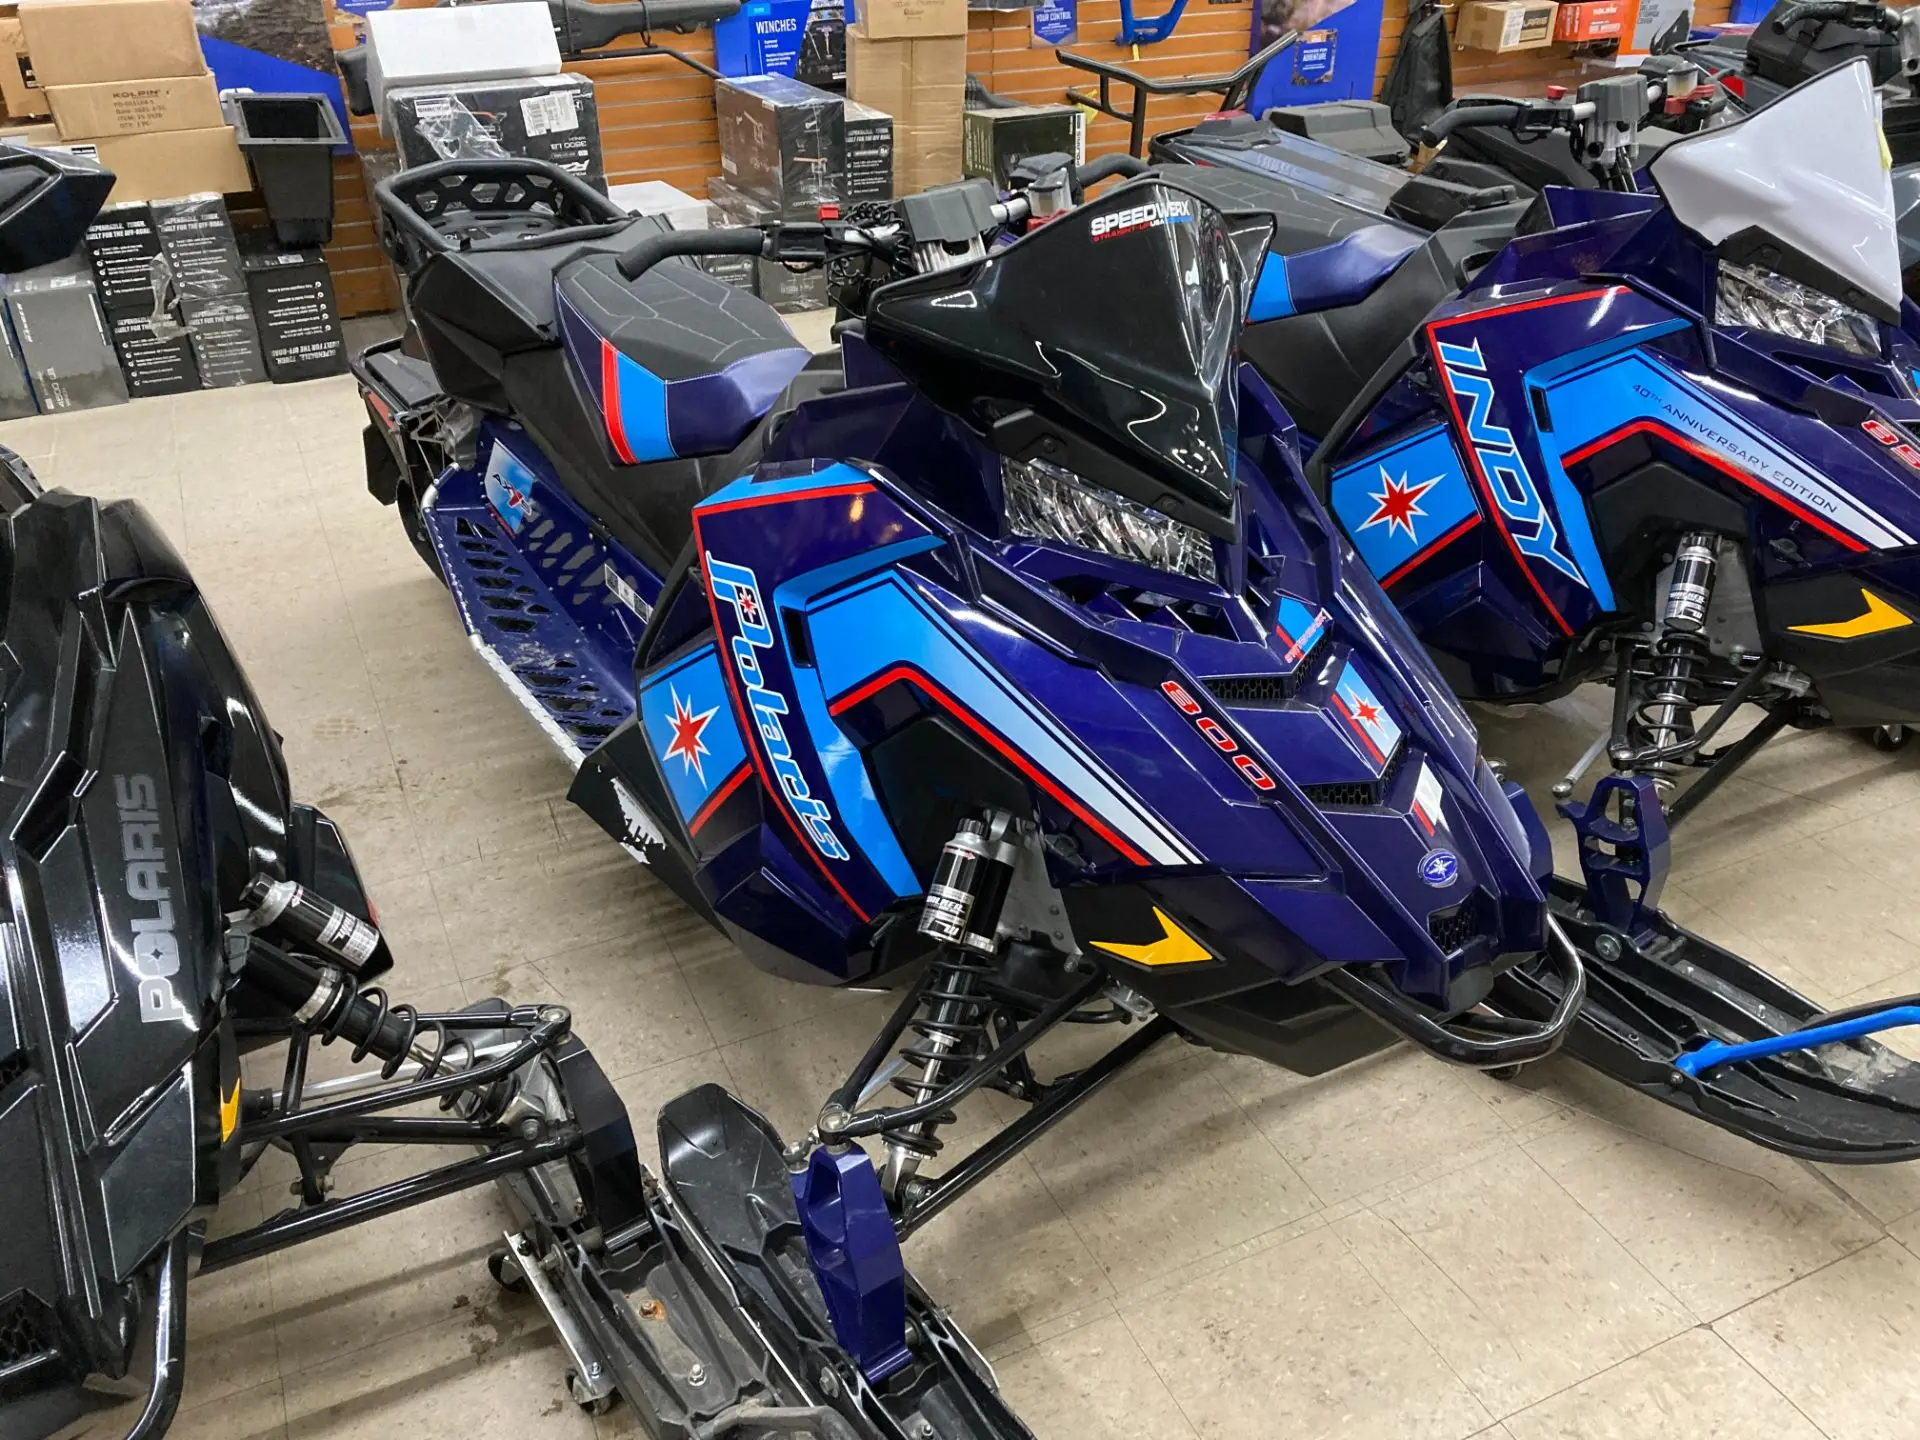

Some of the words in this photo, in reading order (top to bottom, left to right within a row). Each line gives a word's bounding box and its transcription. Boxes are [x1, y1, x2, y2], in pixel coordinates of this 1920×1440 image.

[755, 18, 797, 34] WINCHES
[112, 89, 160, 99] KOLPIN
[1091, 201, 1190, 236] SPEEDWERX
[1437, 337, 1590, 589] INDY
[1662, 403, 1769, 472] ANNIVERSARY
[1773, 470, 1839, 514] EDITION
[705, 550, 850, 862] Polaris
[112, 773, 186, 1024] POLARIS
